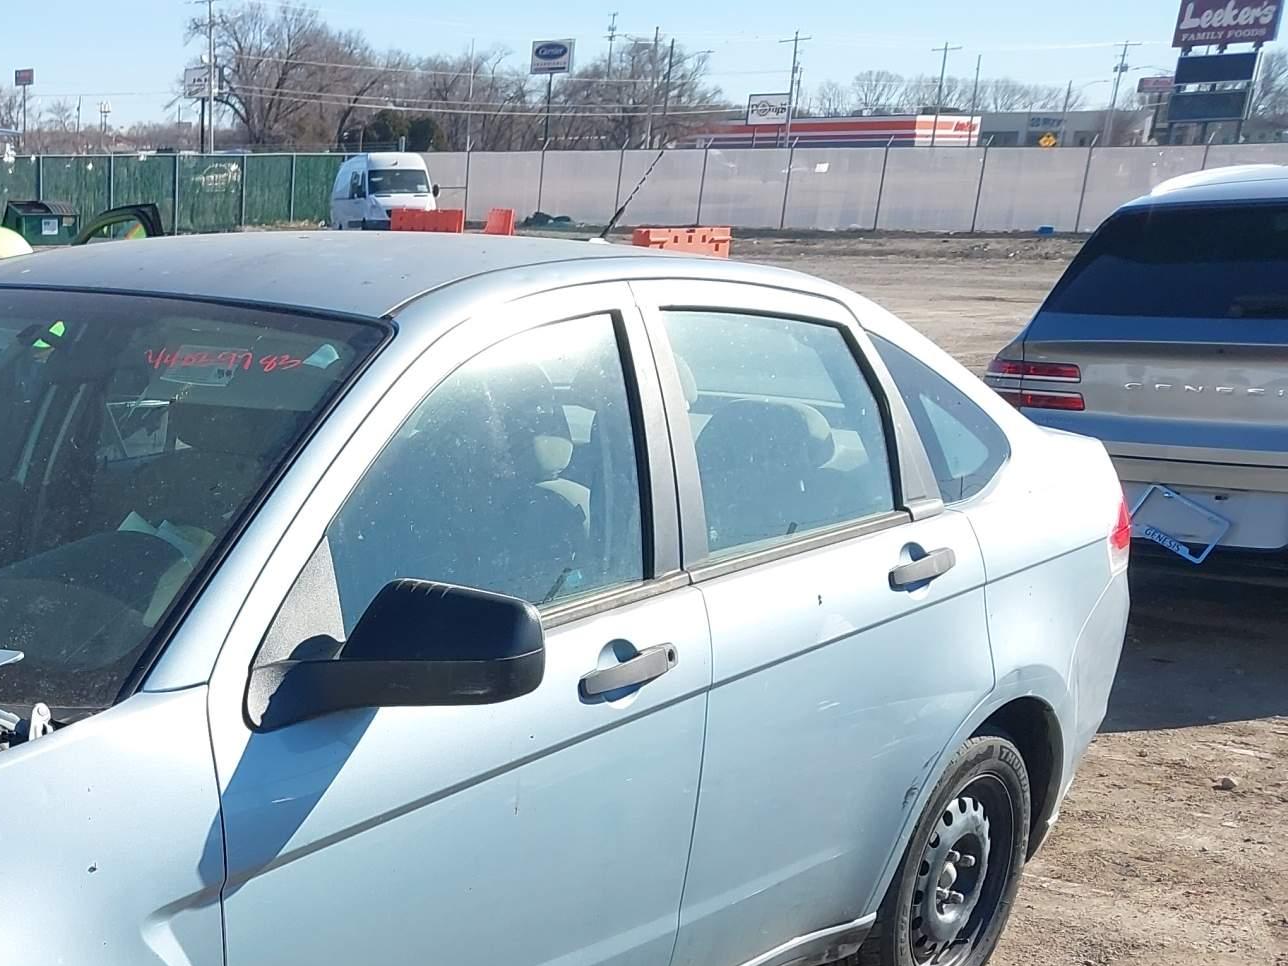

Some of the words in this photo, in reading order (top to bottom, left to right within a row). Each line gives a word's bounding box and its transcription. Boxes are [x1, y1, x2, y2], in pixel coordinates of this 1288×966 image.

[1179, 0, 1276, 30] Leeker's
[1181, 31, 1224, 41] FAMILY
[1226, 28, 1266, 38] FOODS
[1123, 381, 1287, 399] GENESI
[1144, 527, 1181, 552] GENESIS
